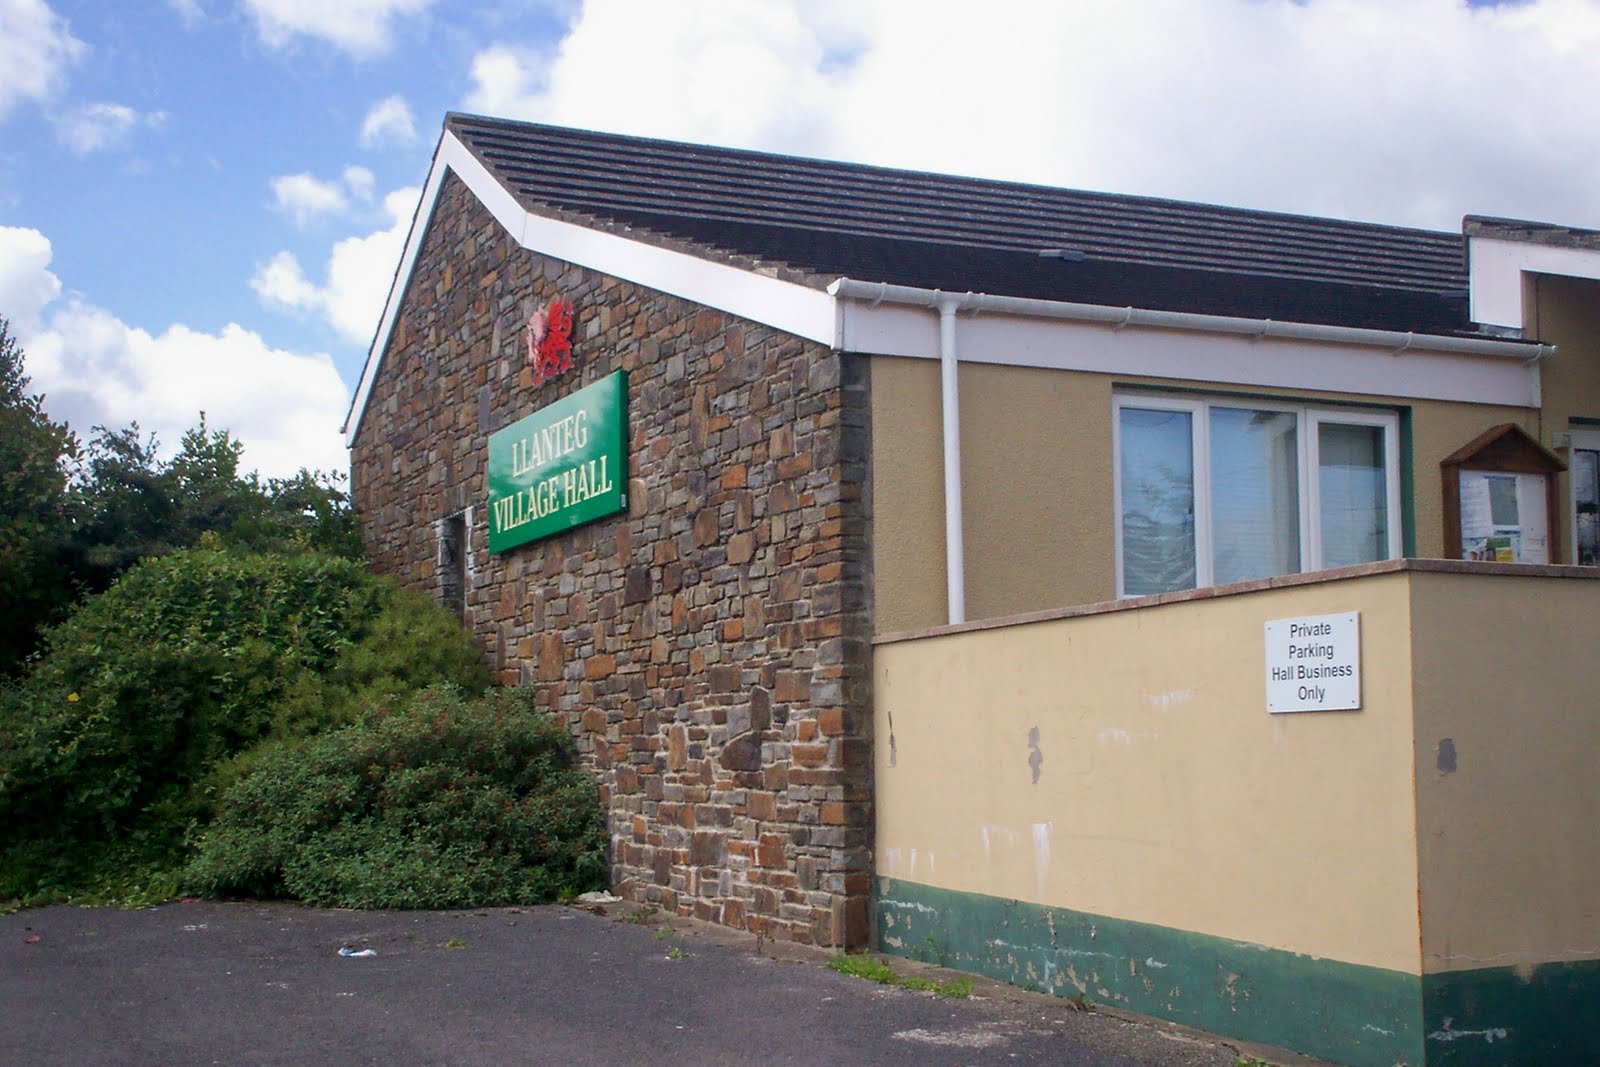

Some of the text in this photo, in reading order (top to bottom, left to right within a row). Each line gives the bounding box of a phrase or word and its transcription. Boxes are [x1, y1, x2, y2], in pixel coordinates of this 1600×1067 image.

[512, 410, 587, 478] LLANTEG
[493, 455, 612, 534] VILLAGE HALL
[1290, 622, 1331, 638] Private
[1289, 643, 1334, 660] Parking
[1272, 663, 1353, 681] Hall Business
[1298, 685, 1326, 703] Only
